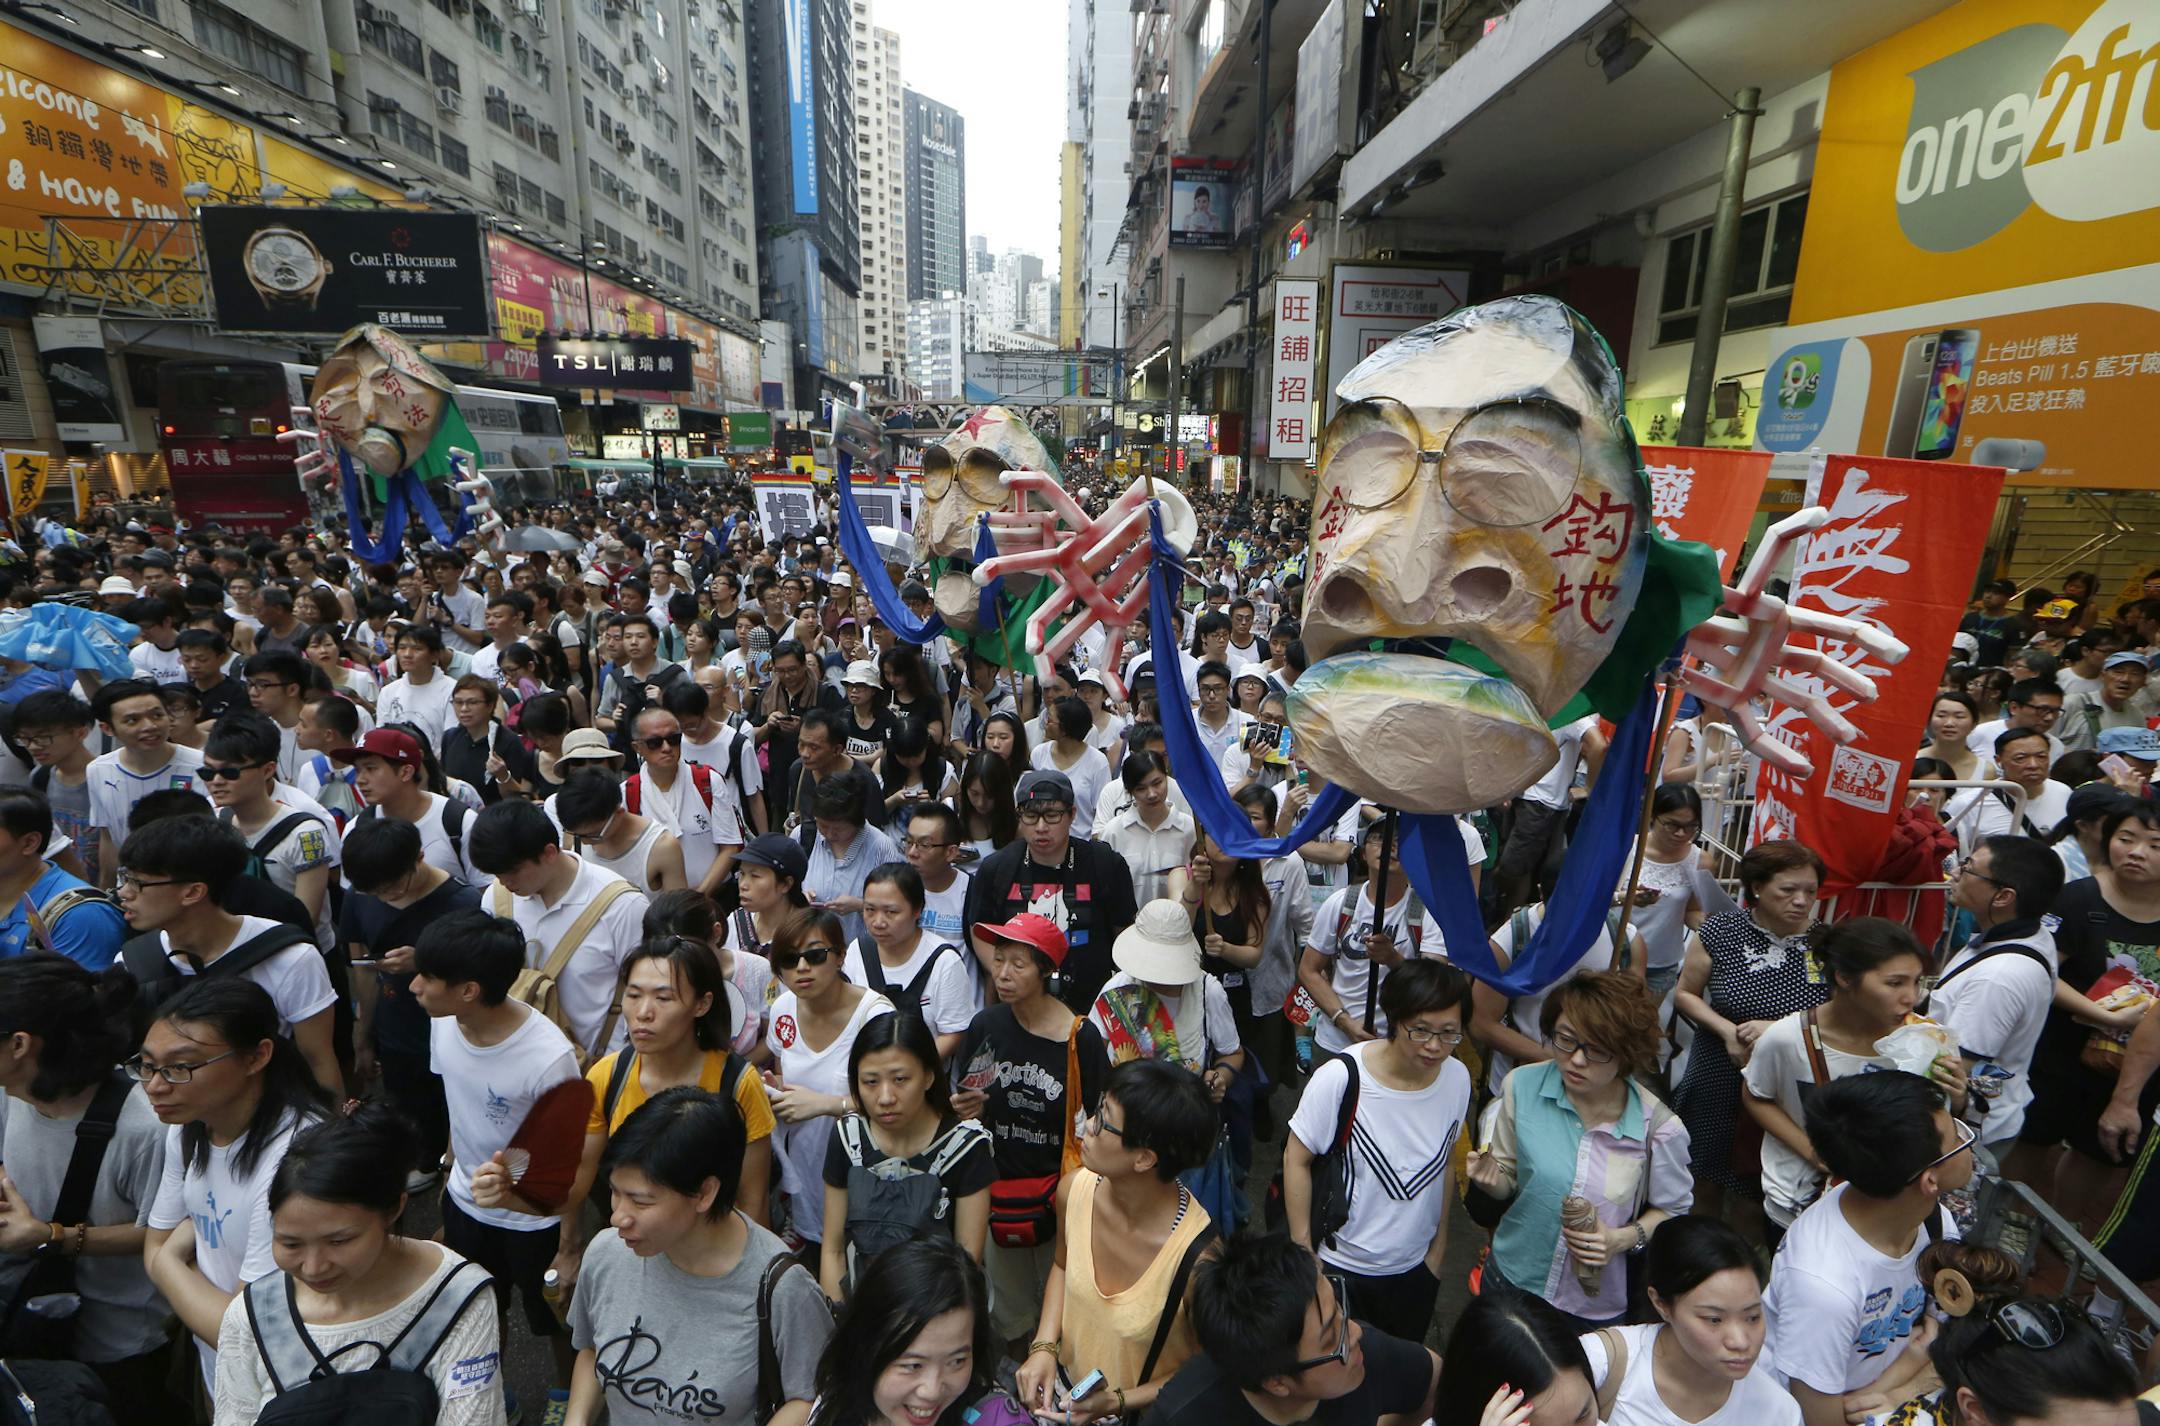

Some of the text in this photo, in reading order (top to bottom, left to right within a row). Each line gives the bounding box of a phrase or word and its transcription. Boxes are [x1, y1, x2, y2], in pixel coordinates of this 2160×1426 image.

[1981, 333, 2079, 364] 上台出機送
[553, 354, 608, 371] TSL
[620, 354, 674, 373] 謝瑞麟
[1976, 367, 2023, 388] Beats
[2027, 361, 2055, 383] Pill
[2061, 359, 2090, 380] 1.5
[1969, 388, 2086, 415] 投入足球狂熱
[171, 449, 232, 466] 周大福
[1859, 789, 1880, 800] 2011
